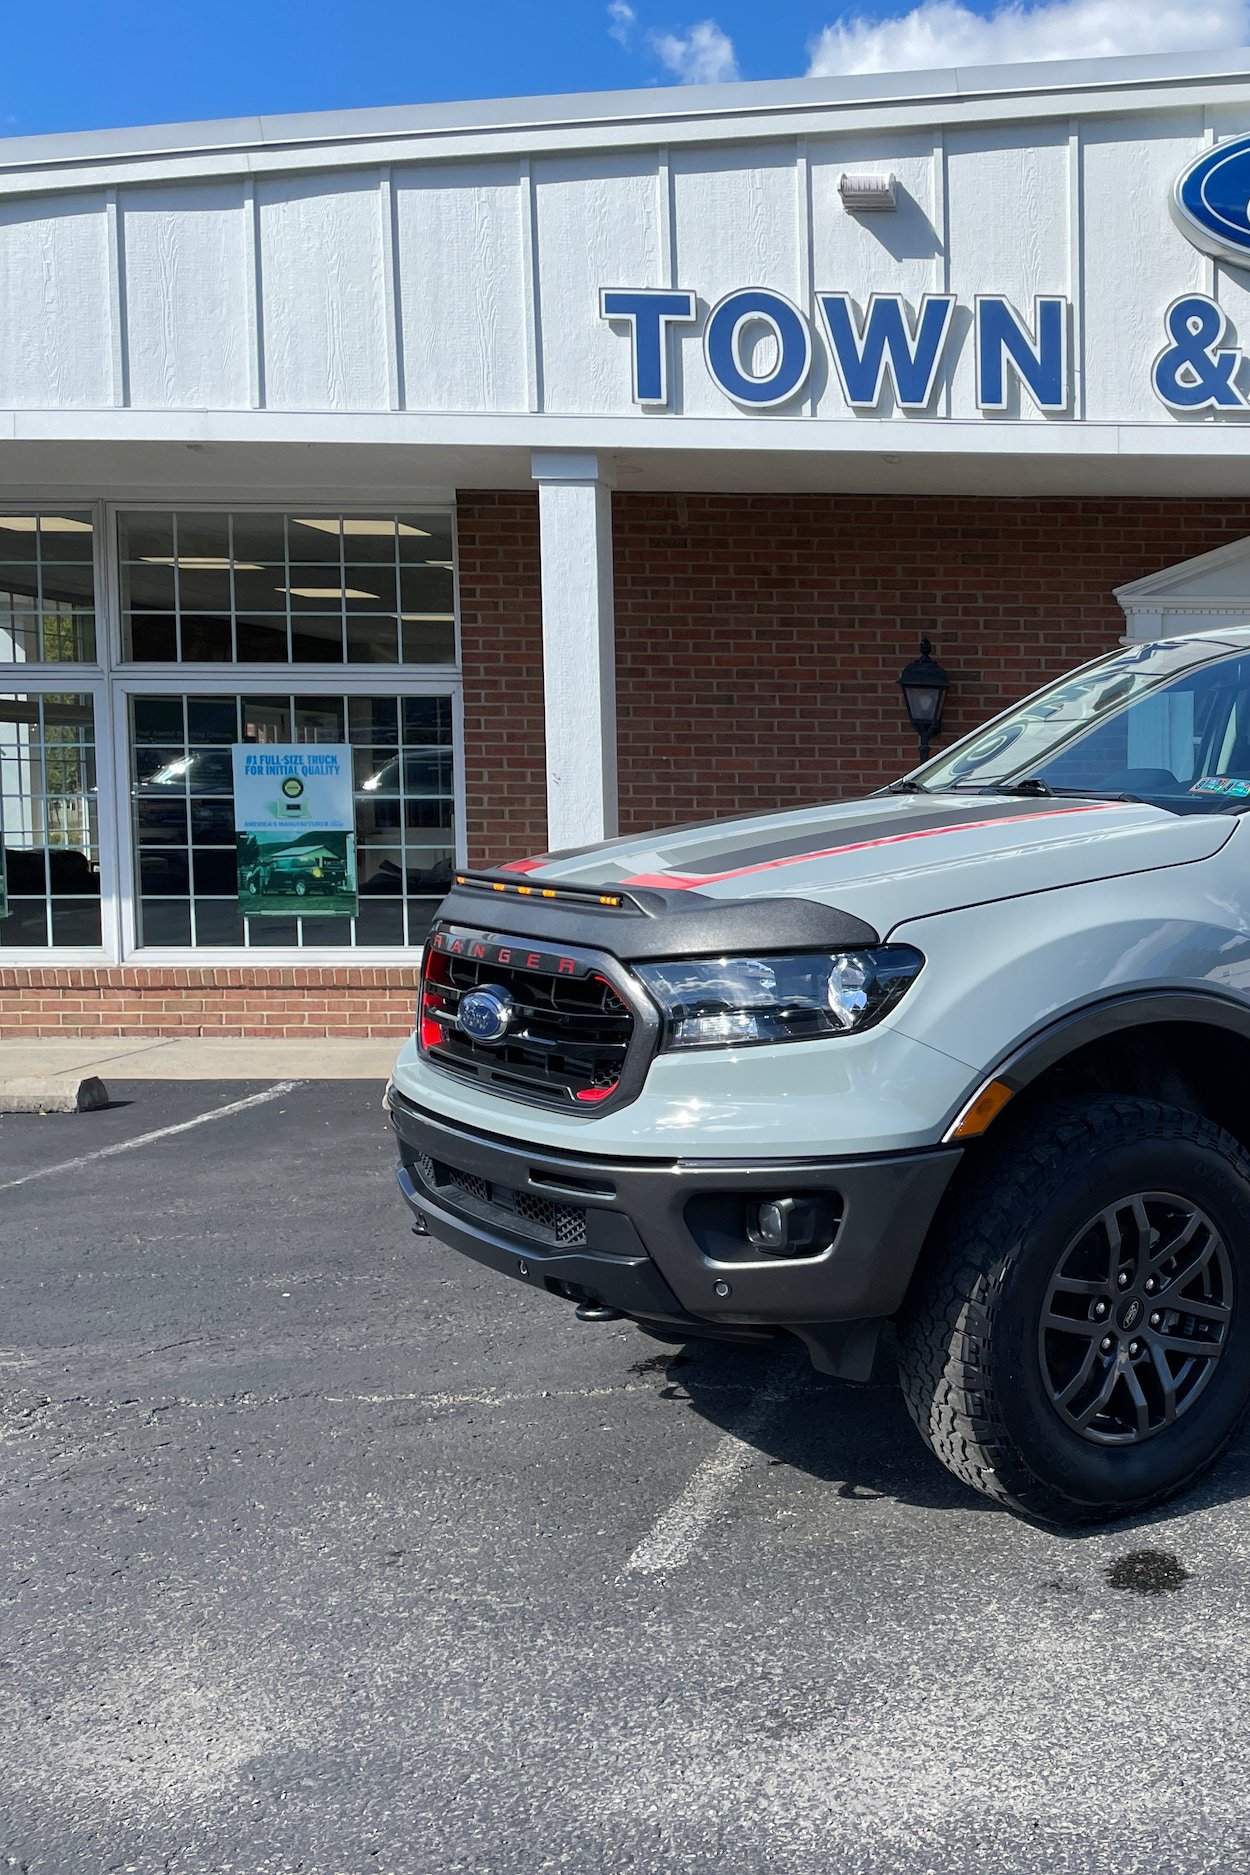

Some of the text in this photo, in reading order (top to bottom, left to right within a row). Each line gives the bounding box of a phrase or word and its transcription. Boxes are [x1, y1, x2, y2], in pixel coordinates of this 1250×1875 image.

[599, 287, 1068, 411] TOWN
[245, 765, 340, 777] FOR INITIAL QUALITY
[246, 755, 338, 766] #1 FULL-SIZE TRUCK
[433, 932, 576, 975] RANGER
